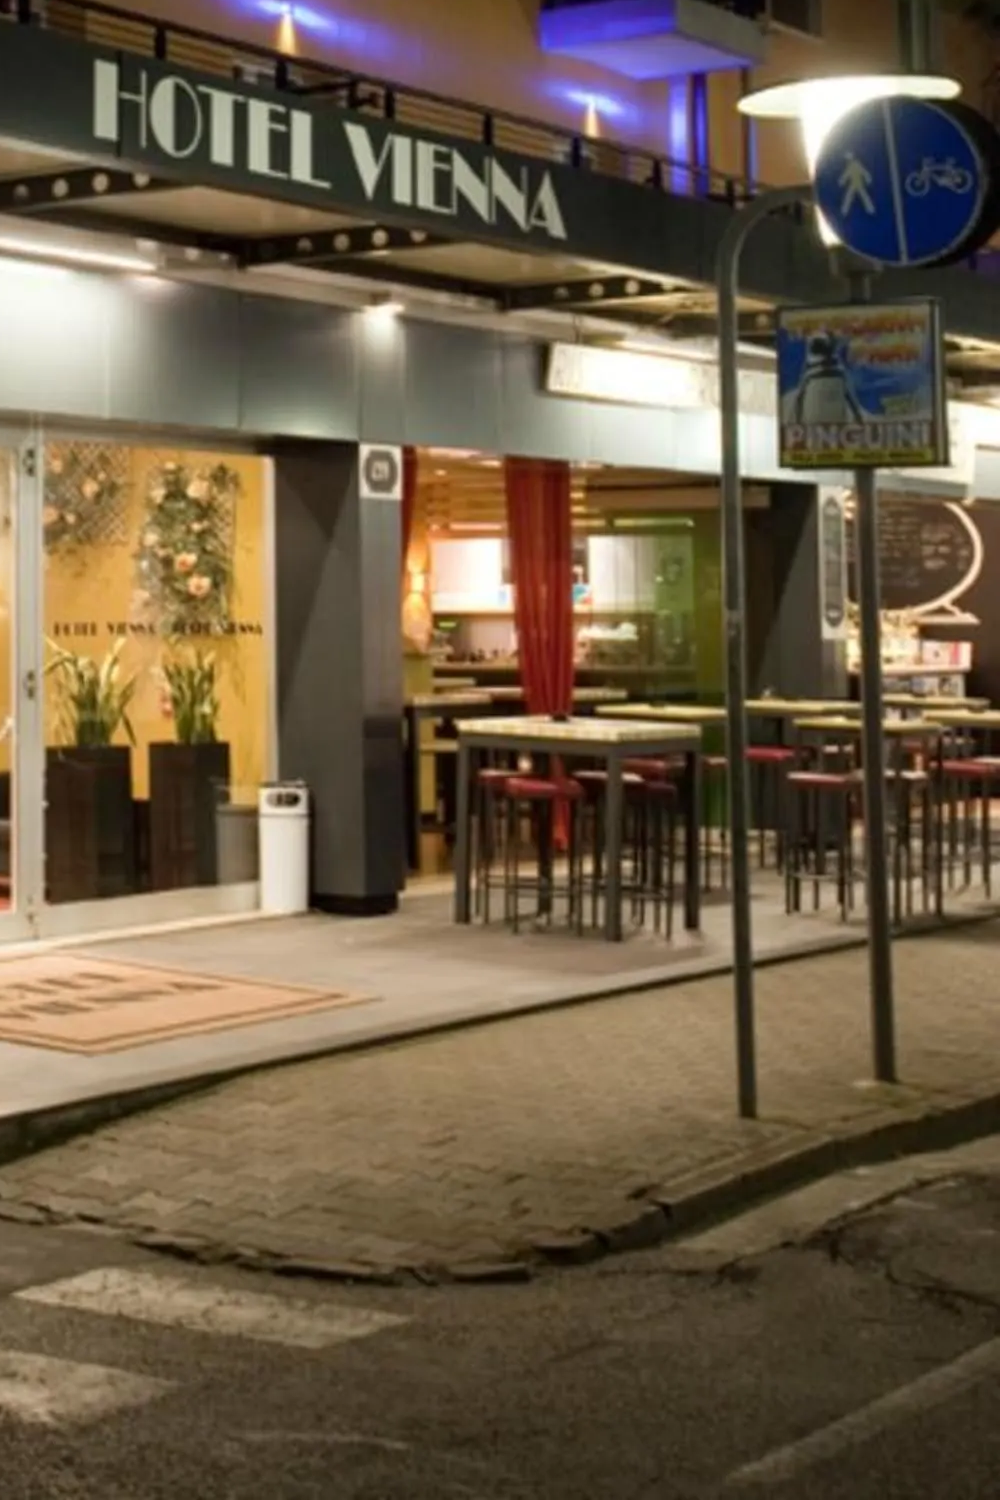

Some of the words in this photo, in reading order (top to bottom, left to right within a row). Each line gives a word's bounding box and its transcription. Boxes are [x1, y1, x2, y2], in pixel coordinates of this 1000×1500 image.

[94, 58, 331, 189] HOTEL
[342, 120, 567, 240] VIENNA
[785, 420, 929, 449] PINGUINI
